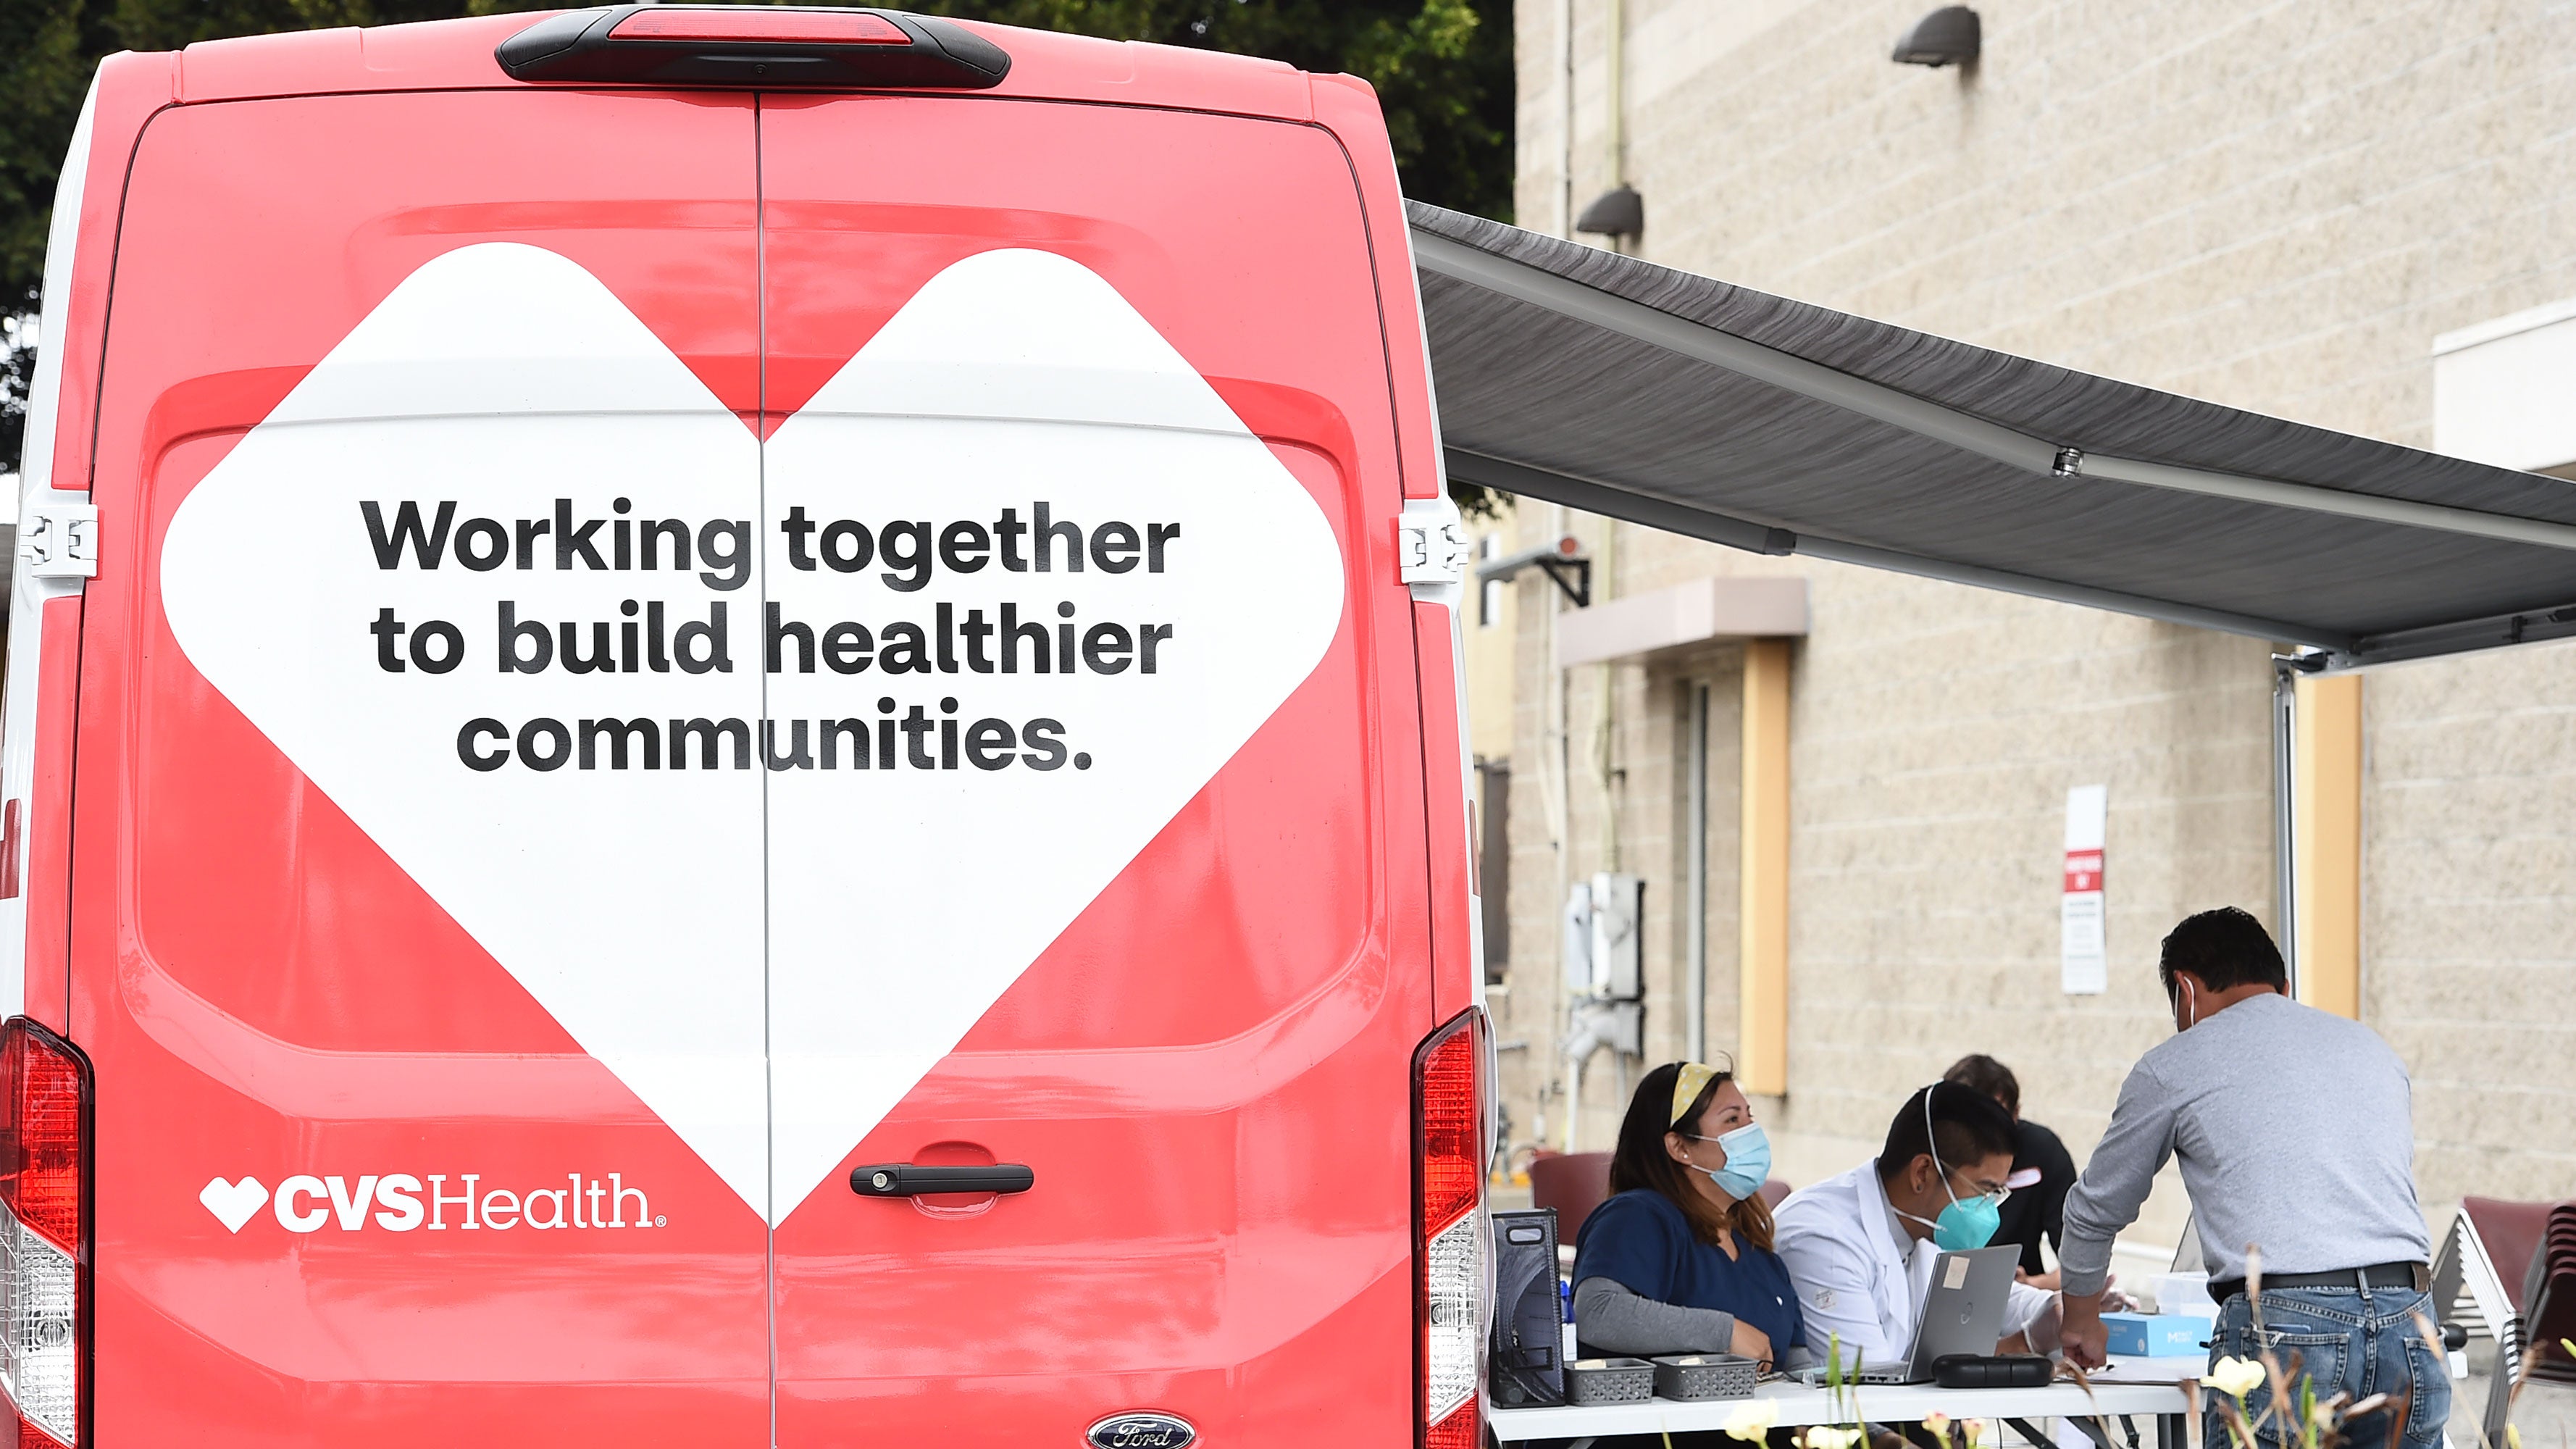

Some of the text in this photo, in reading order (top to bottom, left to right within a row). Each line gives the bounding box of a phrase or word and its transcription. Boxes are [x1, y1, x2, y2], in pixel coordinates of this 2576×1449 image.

[360, 496, 1181, 593] Working together
[370, 599, 1174, 675] to build healthier
[456, 696, 1092, 772] communities.
[1112, 1422, 1173, 1447] Ford
